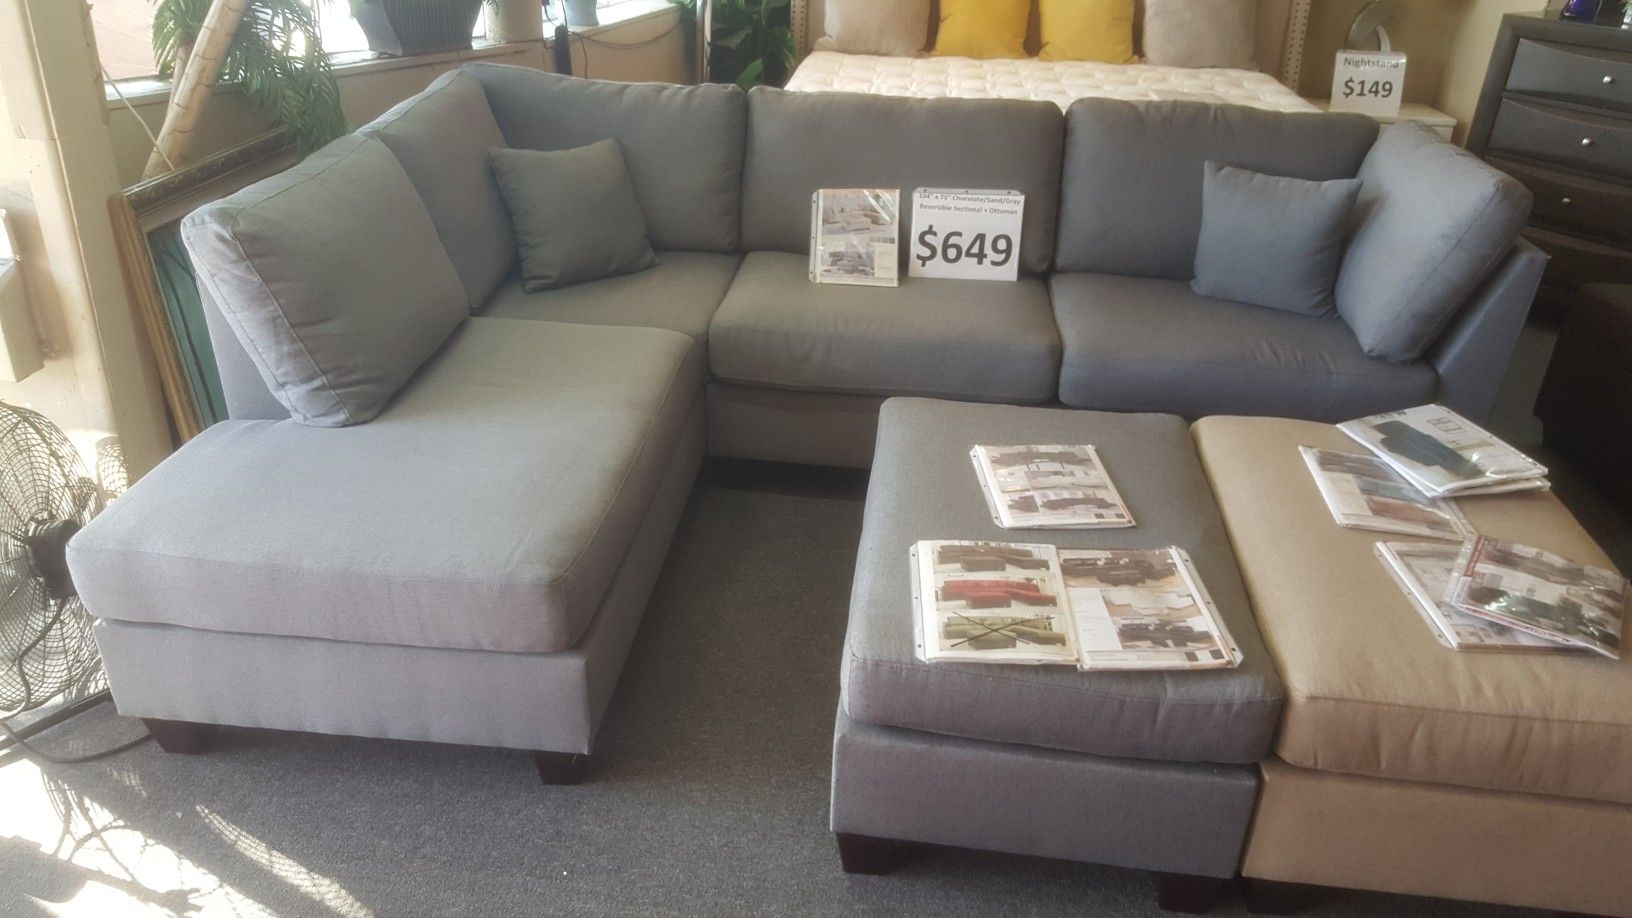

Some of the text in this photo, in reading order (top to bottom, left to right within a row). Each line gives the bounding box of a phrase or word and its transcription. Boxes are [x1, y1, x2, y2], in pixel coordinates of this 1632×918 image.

[1343, 57, 1399, 69] Nightstand
[1342, 77, 1393, 99] $149
[919, 203, 952, 211] Reversible
[953, 205, 983, 213] Sectional
[989, 207, 1018, 215] Ottoman
[916, 224, 1013, 268] $649
